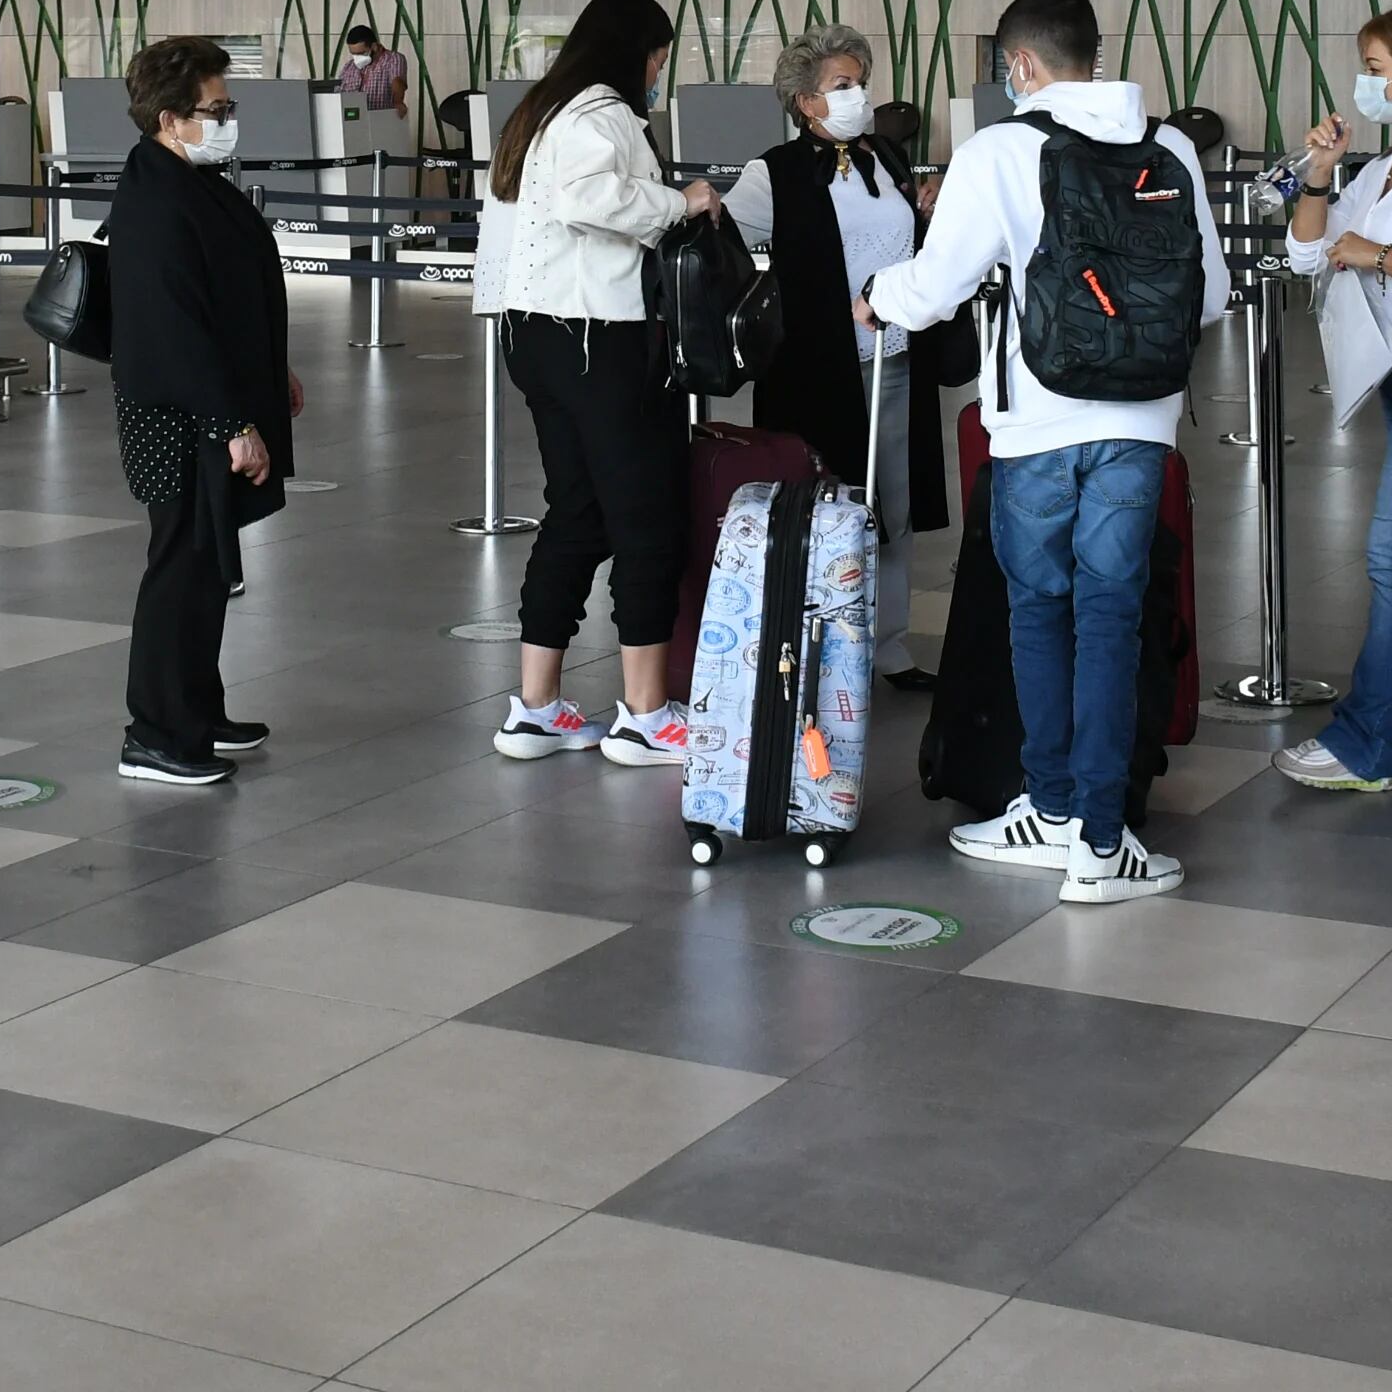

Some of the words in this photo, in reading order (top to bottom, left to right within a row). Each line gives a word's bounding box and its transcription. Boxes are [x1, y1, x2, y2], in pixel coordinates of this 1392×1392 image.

[289, 221, 318, 232] opam
[406, 225, 436, 237] opam
[292, 260, 328, 273] opam
